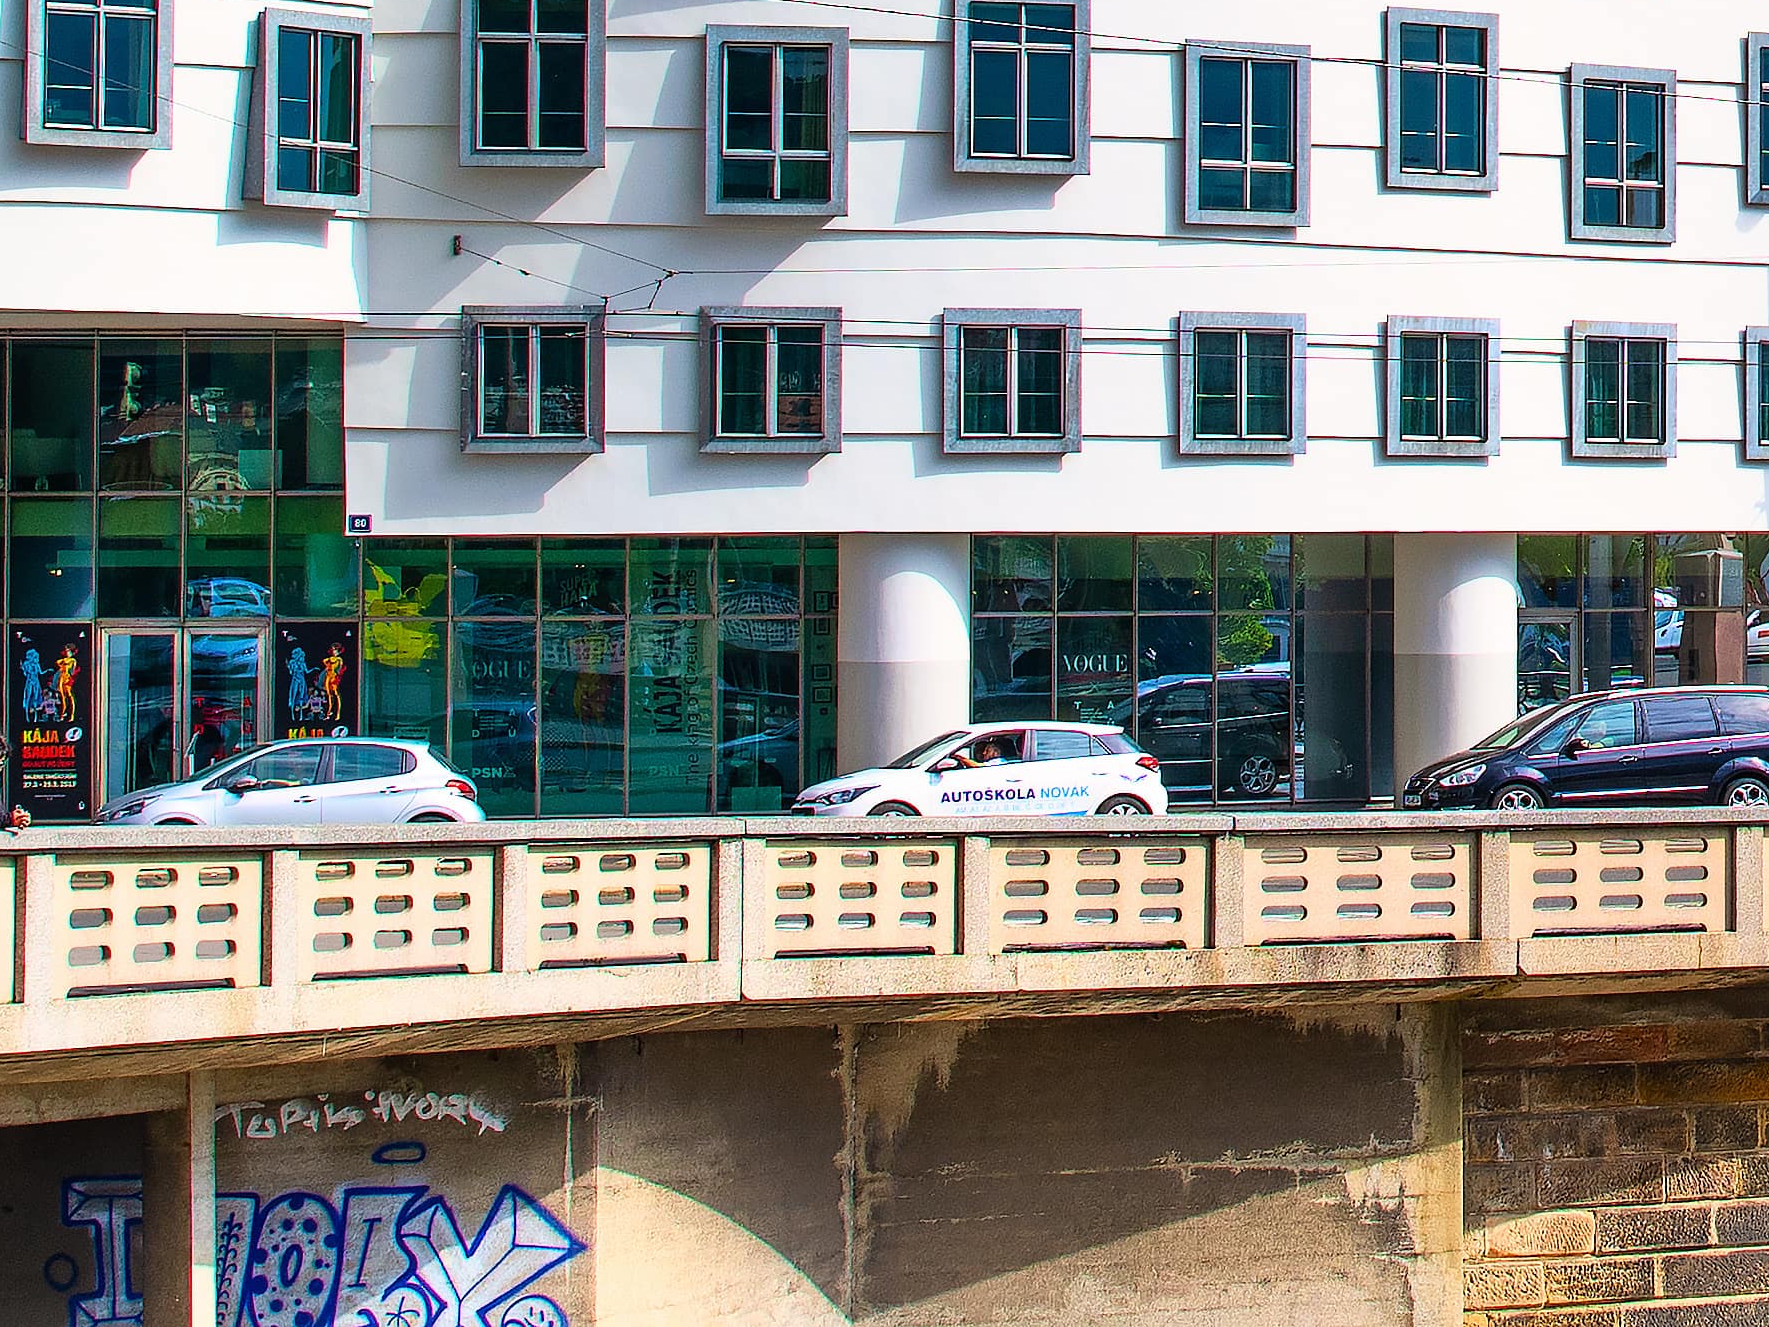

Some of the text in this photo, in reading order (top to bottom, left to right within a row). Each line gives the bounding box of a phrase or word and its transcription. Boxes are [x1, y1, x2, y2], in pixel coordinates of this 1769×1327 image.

[354, 518, 367, 528] 80
[683, 635, 698, 685] Czech
[1063, 654, 1128, 673] VOGUE
[643, 674, 682, 733] KÁJA
[684, 689, 699, 708] of
[23, 727, 60, 744] KÁJA
[684, 712, 702, 746] king
[22, 745, 76, 759] SAUDEK
[471, 767, 503, 779] PSN
[684, 753, 699, 785] The
[940, 786, 1037, 804] AUTOŠKOLA
